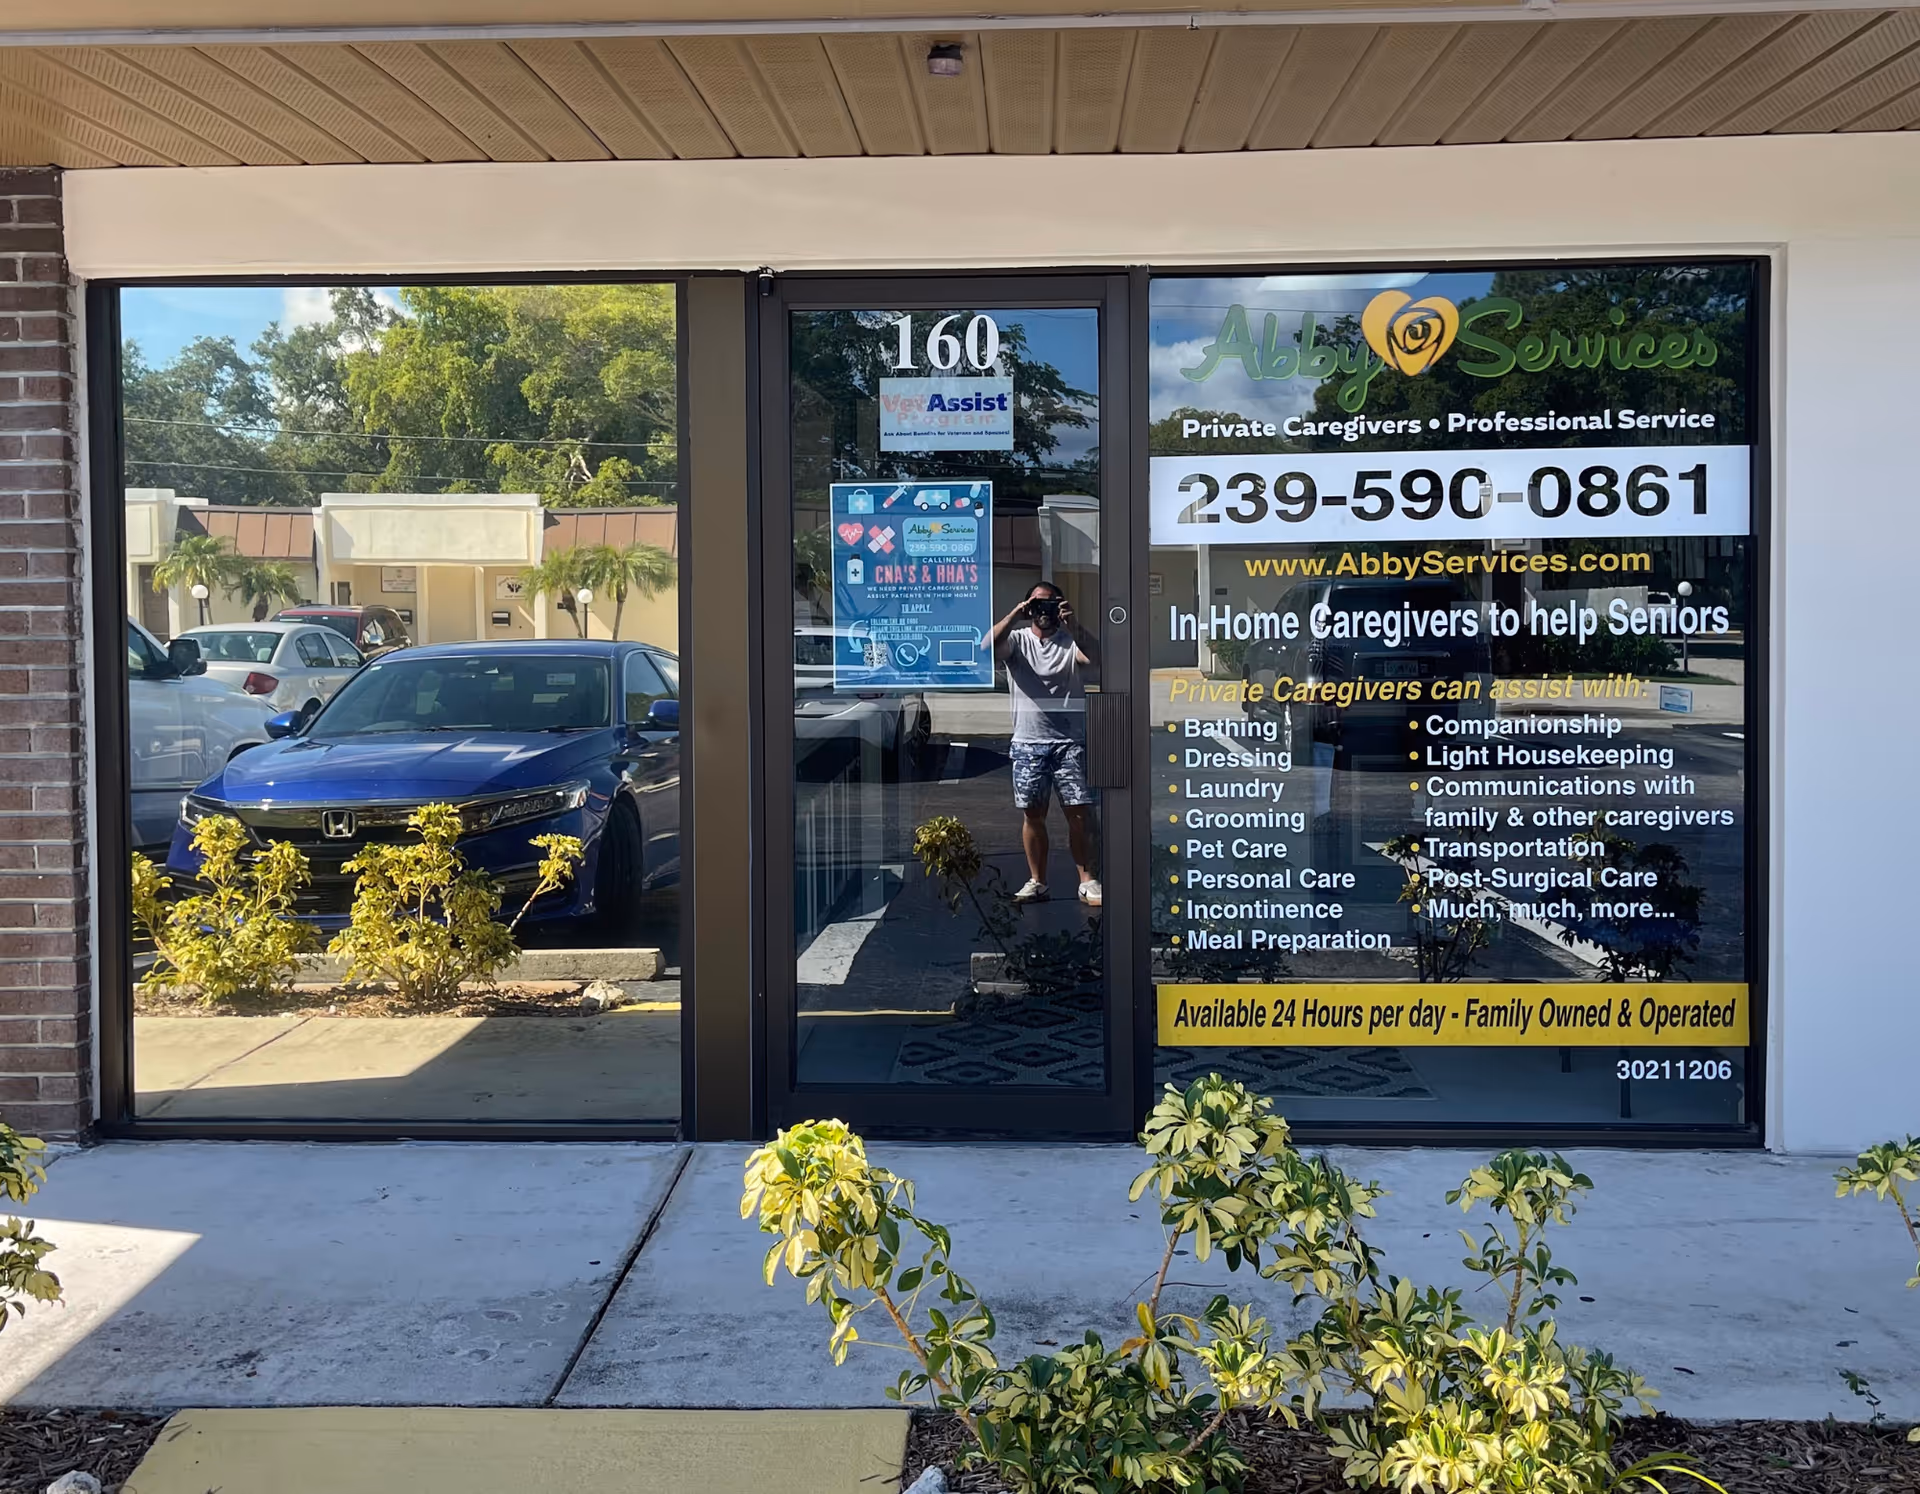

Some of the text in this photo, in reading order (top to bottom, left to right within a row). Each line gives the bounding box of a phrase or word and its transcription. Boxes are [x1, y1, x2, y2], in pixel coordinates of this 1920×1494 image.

[891, 314, 1000, 370] 160
[1180, 298, 1718, 412] Abby Services
[1182, 410, 1715, 442] Private Caregivers Professional Service
[1177, 463, 1708, 524] 239-590-0861
[908, 523, 975, 537] Abby Services
[875, 565, 916, 584] CNA'S
[922, 565, 931, 583] &
[1244, 550, 1651, 581] www.AbbyServices.com
[1170, 598, 1729, 648] In-Home Caregivers to help Seniors
[1169, 674, 1650, 708] Private Caregivers can assist with:
[1184, 718, 1278, 742] Bathing
[1426, 715, 1622, 738] Companionship
[1184, 748, 1292, 772] Dressing
[1426, 745, 1674, 770] Light Housekeeping
[1185, 779, 1284, 802] Laundry
[1426, 776, 1695, 796] Communications with
[1186, 809, 1305, 832] Grooming
[1424, 806, 1734, 832] family & other caregivers
[1186, 840, 1288, 859] Pet Care
[1424, 838, 1605, 862] Transportation
[1186, 870, 1356, 890] Personal Care
[1428, 868, 1658, 892] Post-Surgical Care
[1186, 900, 1344, 920] Incontinence
[1428, 898, 1675, 922] Much, much, more...
[1188, 930, 1391, 954] Meal Preparation
[1174, 1000, 1266, 1028] Available
[1271, 1000, 1296, 1028] 24
[1302, 1000, 1364, 1028] Hours
[1369, 1004, 1404, 1034] per
[1408, 1000, 1446, 1034] day
[1465, 999, 1532, 1034] Family
[1538, 999, 1610, 1028] Owned
[1617, 999, 1632, 1028] &
[1639, 998, 1735, 1034] Operated
[1616, 1060, 1732, 1080] 30211206
